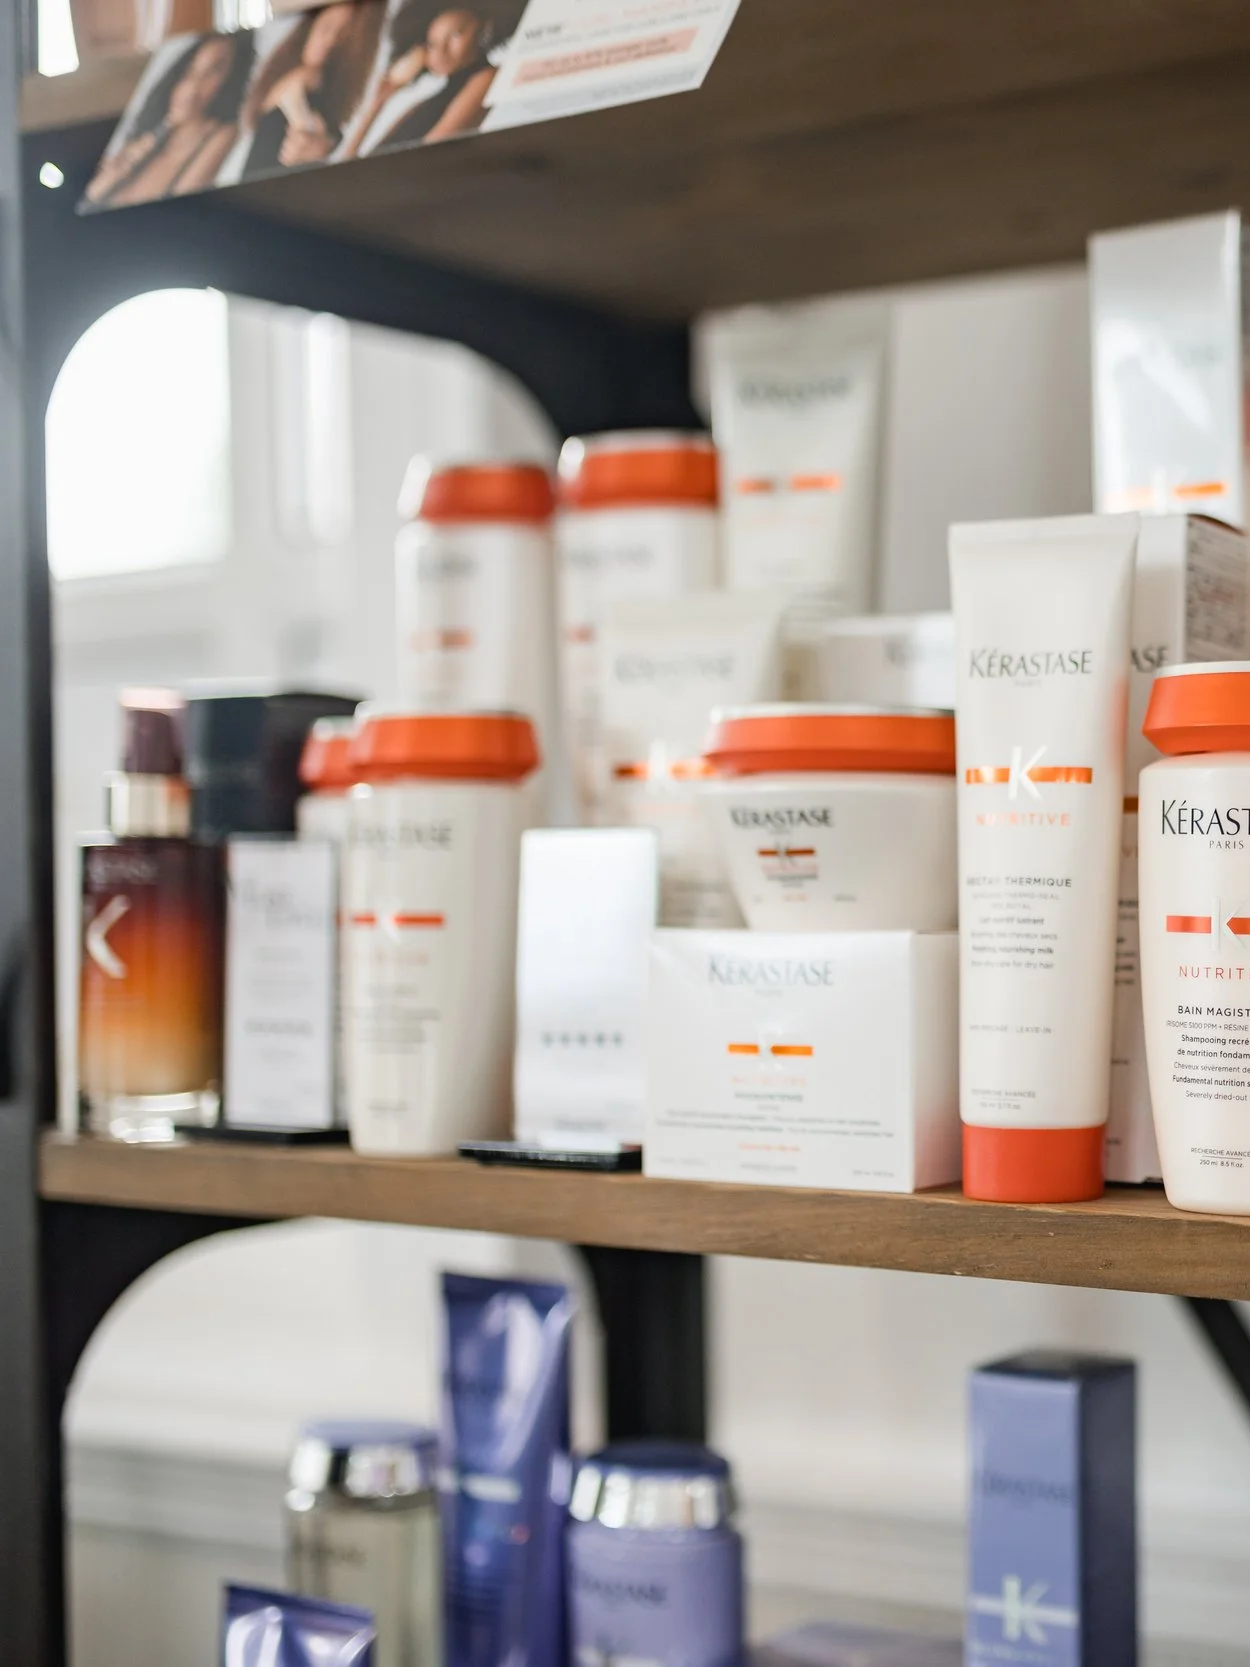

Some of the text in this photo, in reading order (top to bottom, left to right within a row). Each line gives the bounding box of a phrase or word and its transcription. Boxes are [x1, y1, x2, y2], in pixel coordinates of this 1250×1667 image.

[968, 647, 1094, 681] KÉRASTASE
[1007, 743, 1049, 801] K
[975, 813, 1071, 827] NURITIVE
[1208, 839, 1246, 850] PARIS
[1004, 877, 1073, 888] THERMIQUE
[1177, 1005, 1202, 1016] BAIN
[1203, 1022, 1218, 1031] PPM
[1223, 1023, 1249, 1032] RÉSINE
[1181, 1034, 1227, 1046] Shampooing
[1177, 1048, 1186, 1056] de
[1186, 1049, 1218, 1059] nutrition
[1173, 1061, 1200, 1071] Cheveux
[1172, 1074, 1213, 1086] Fundamental
[1214, 1078, 1246, 1087] nutrition
[1185, 1090, 1213, 1101] Severely
[1214, 1092, 1248, 1102] dried-out
[1190, 1147, 1225, 1157] RECHERCHE
